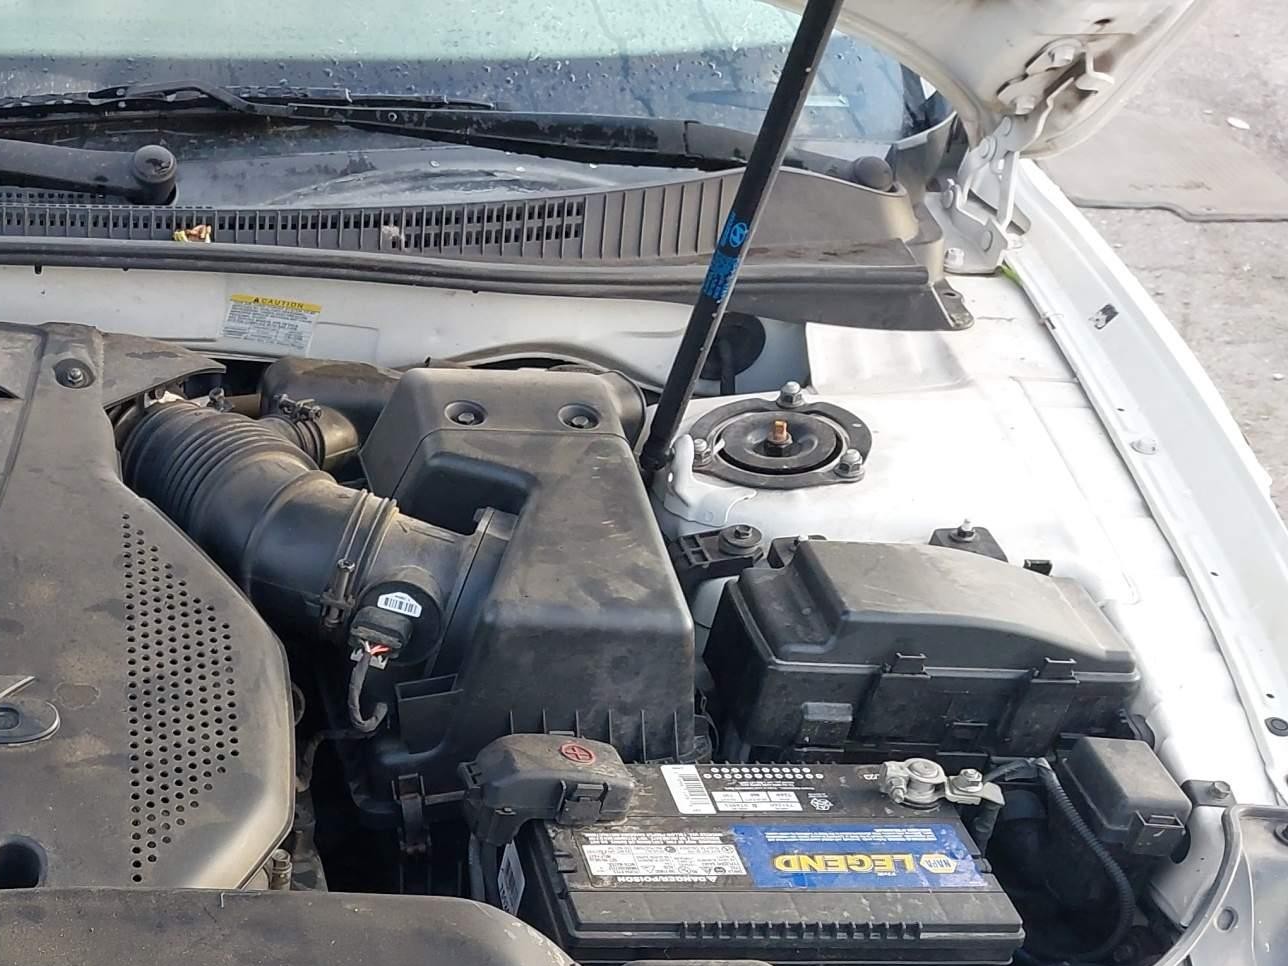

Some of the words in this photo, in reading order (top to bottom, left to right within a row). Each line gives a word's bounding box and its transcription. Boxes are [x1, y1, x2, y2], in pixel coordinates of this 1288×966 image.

[262, 298, 305, 310] CAUTION
[773, 853, 913, 873] LEGEND
[925, 858, 952, 869] NAPA
[616, 875, 706, 883] DANGER/POISON
